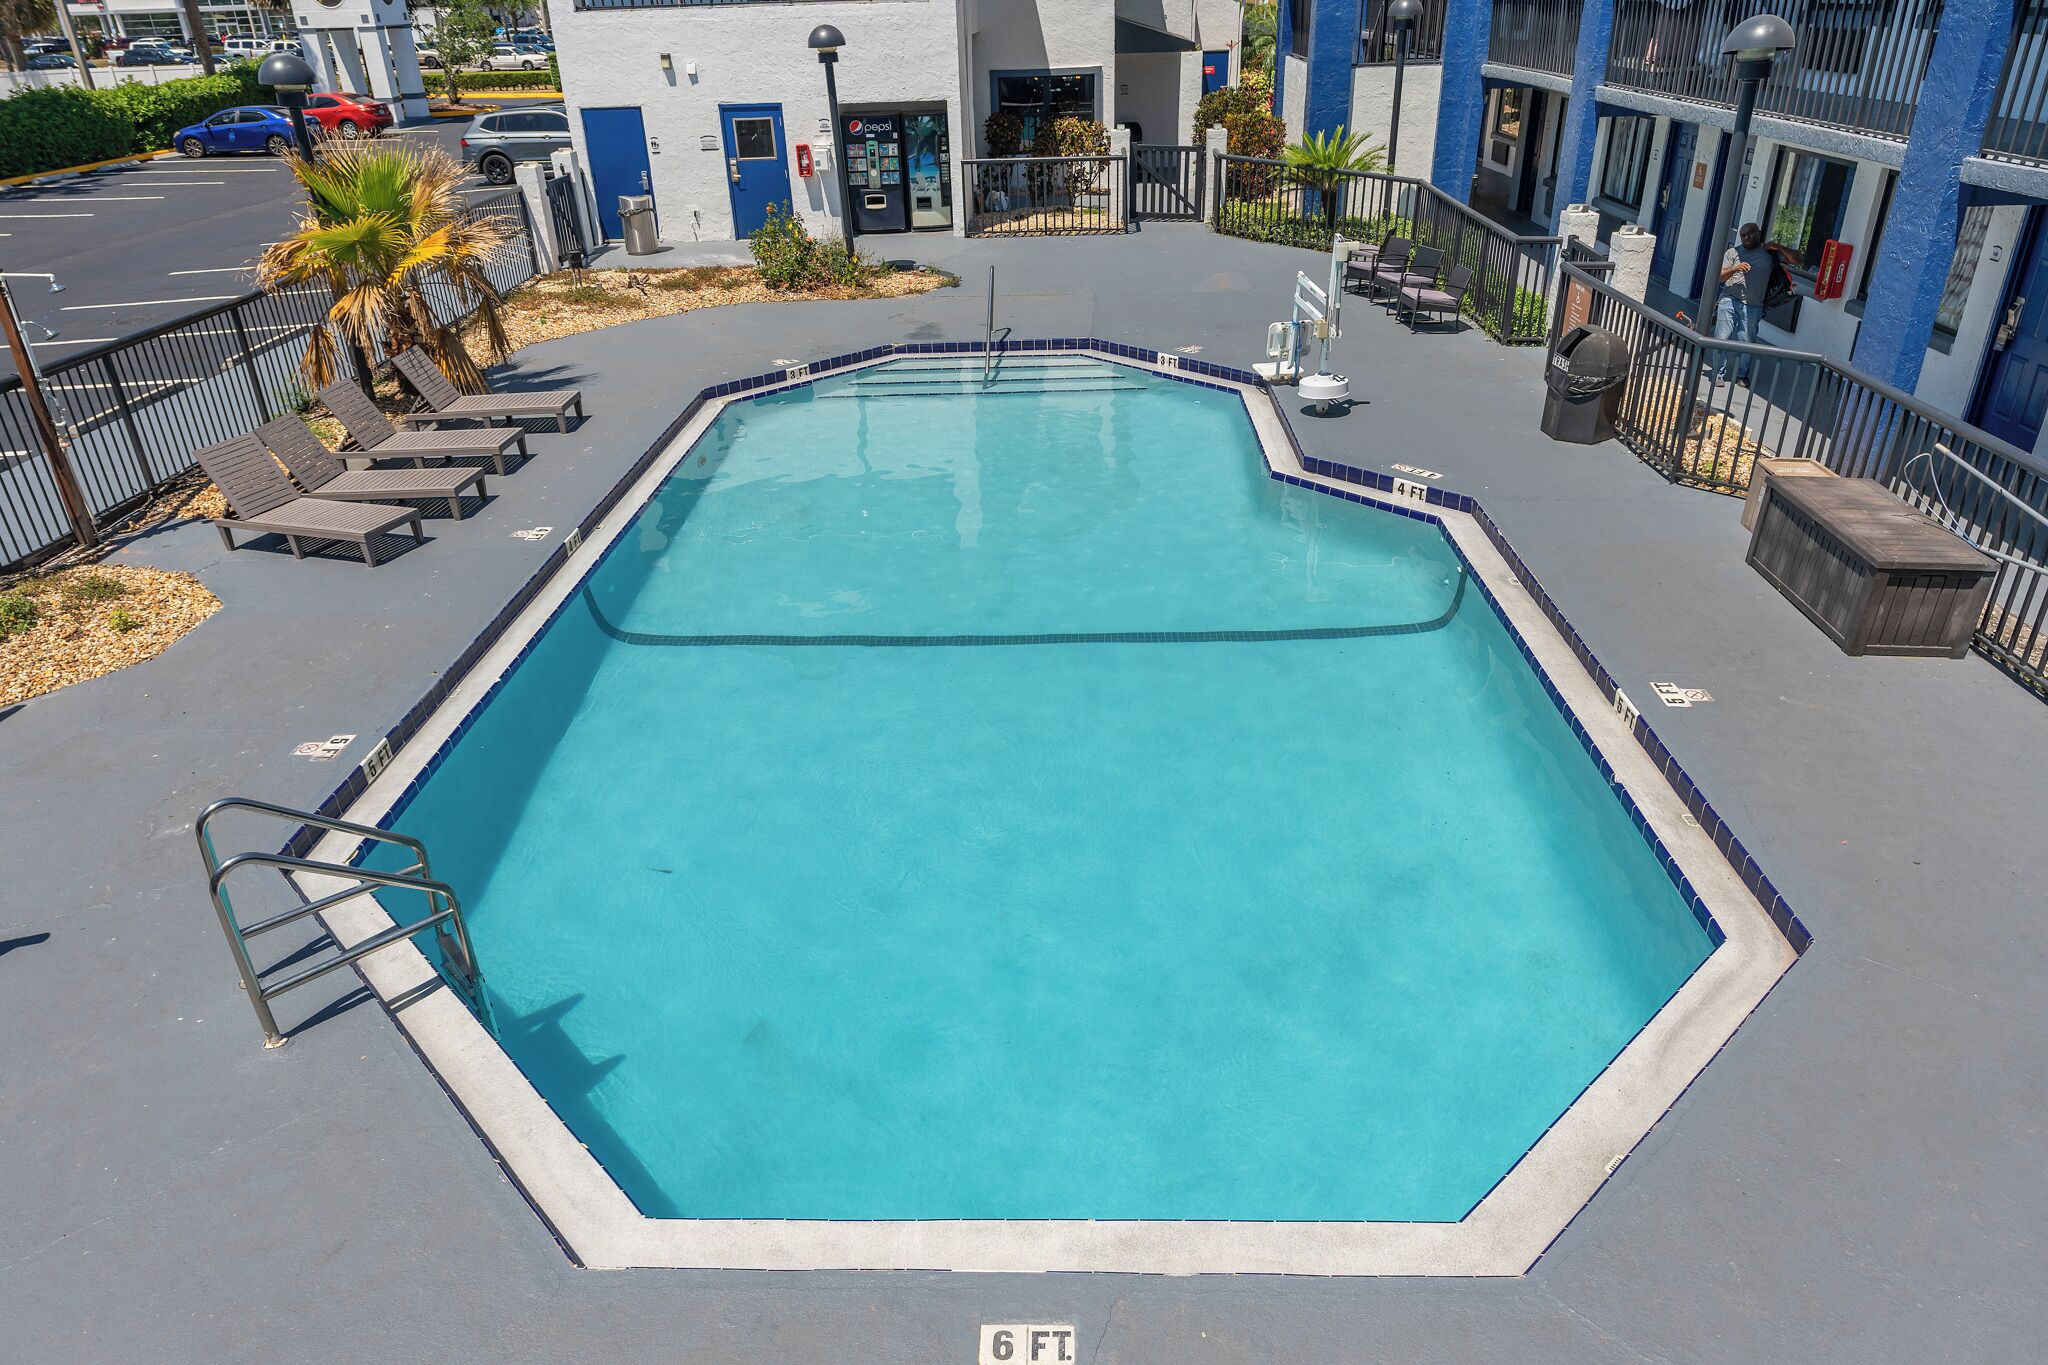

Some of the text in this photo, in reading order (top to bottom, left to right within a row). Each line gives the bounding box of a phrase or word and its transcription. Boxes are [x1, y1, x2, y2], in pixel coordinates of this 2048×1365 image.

[864, 121, 892, 133] pepsi
[1160, 355, 1166, 366] 3
[790, 370, 796, 379] 3
[1397, 482, 1405, 495] 4
[568, 540, 575, 552] 4
[1616, 697, 1624, 714] 5
[330, 737, 349, 745] 5
[367, 760, 377, 778] 5
[992, 1329, 1072, 1361] 6 FT.
